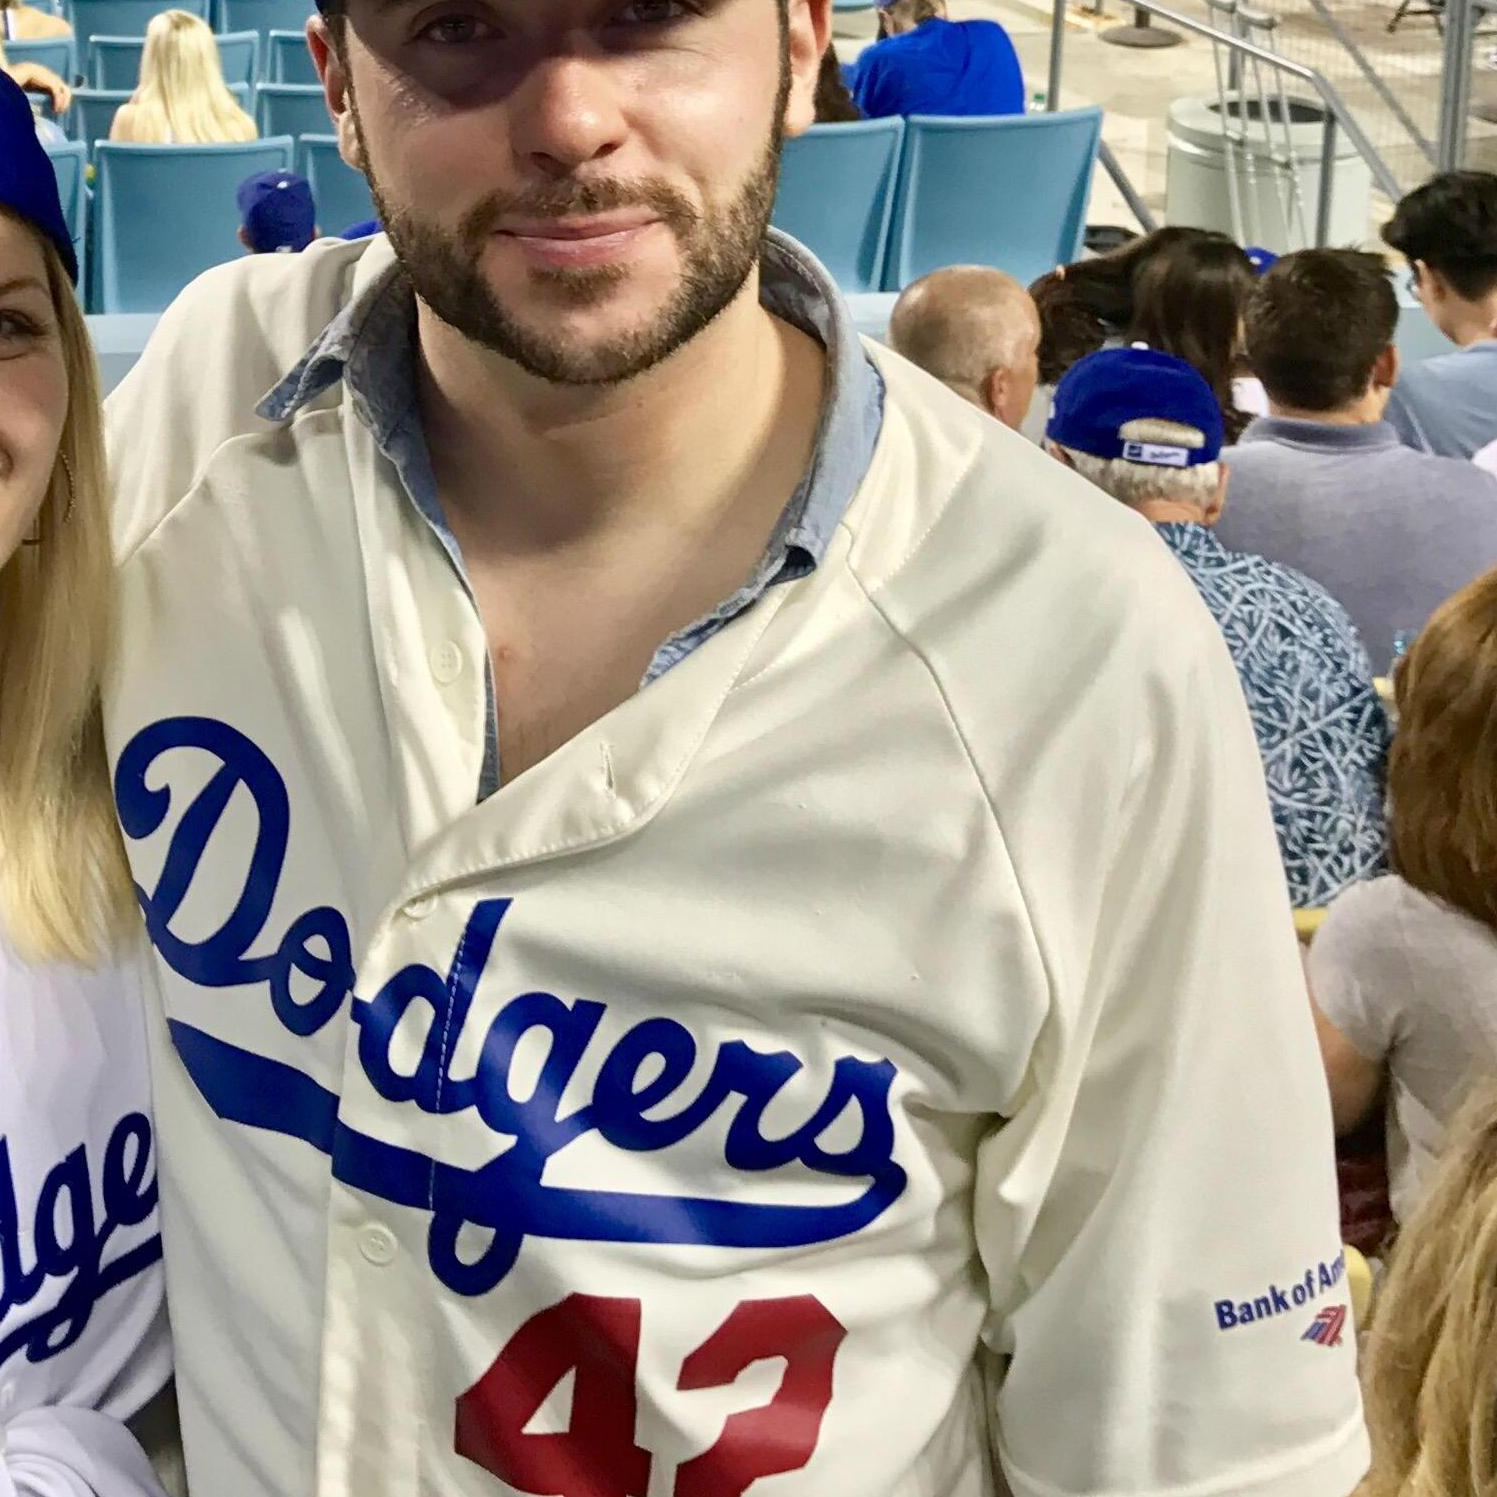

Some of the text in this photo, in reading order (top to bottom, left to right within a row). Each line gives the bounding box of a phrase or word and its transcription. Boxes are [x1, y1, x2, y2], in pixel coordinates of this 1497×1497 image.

[113, 716, 908, 1296] Dodgers
[1214, 1250, 1345, 1331] Bank of Am
[454, 1292, 847, 1497] 42
